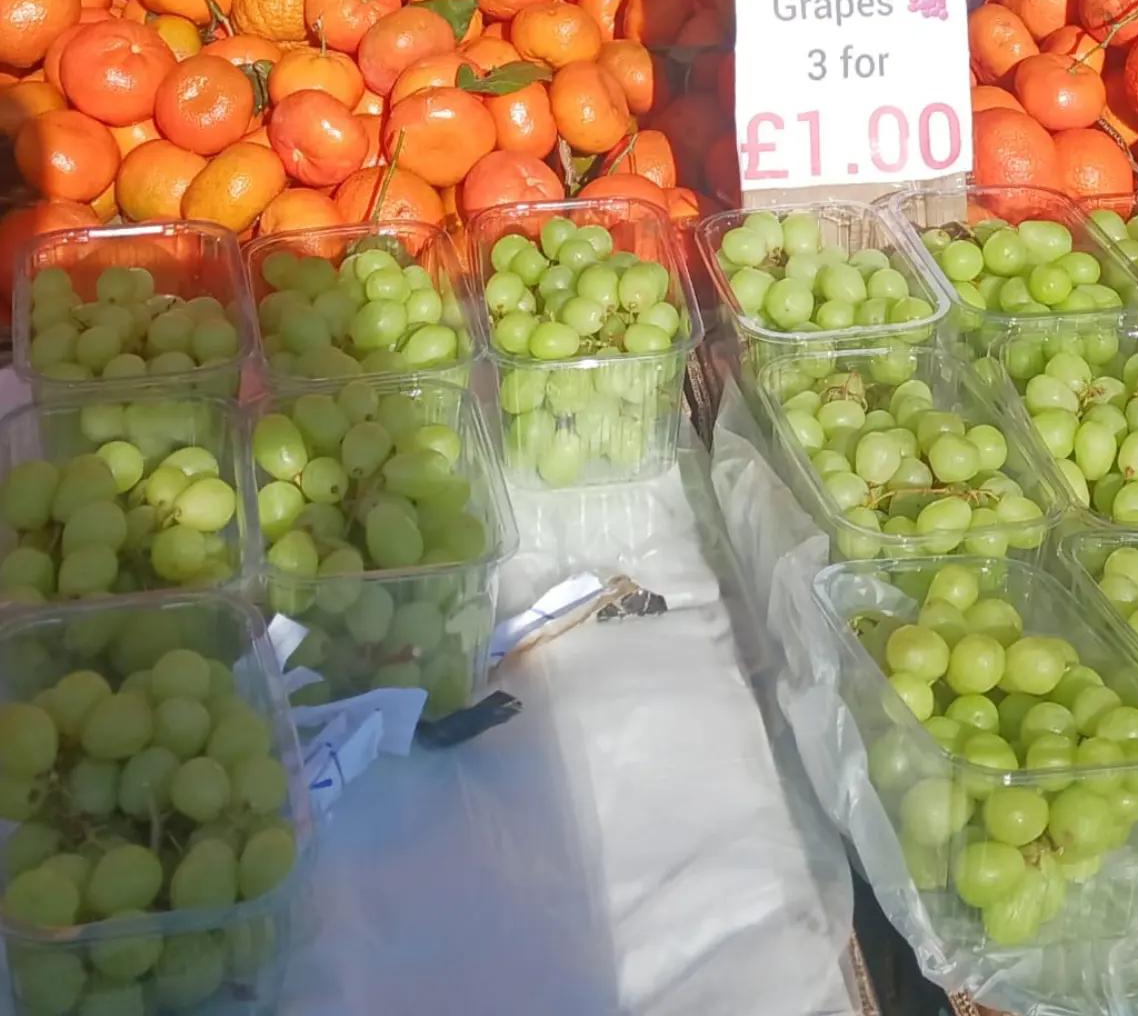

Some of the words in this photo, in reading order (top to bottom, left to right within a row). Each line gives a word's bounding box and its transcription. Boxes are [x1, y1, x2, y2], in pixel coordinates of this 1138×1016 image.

[806, 48, 828, 81] 3
[840, 44, 890, 79] for
[740, 101, 963, 181] £1.00
